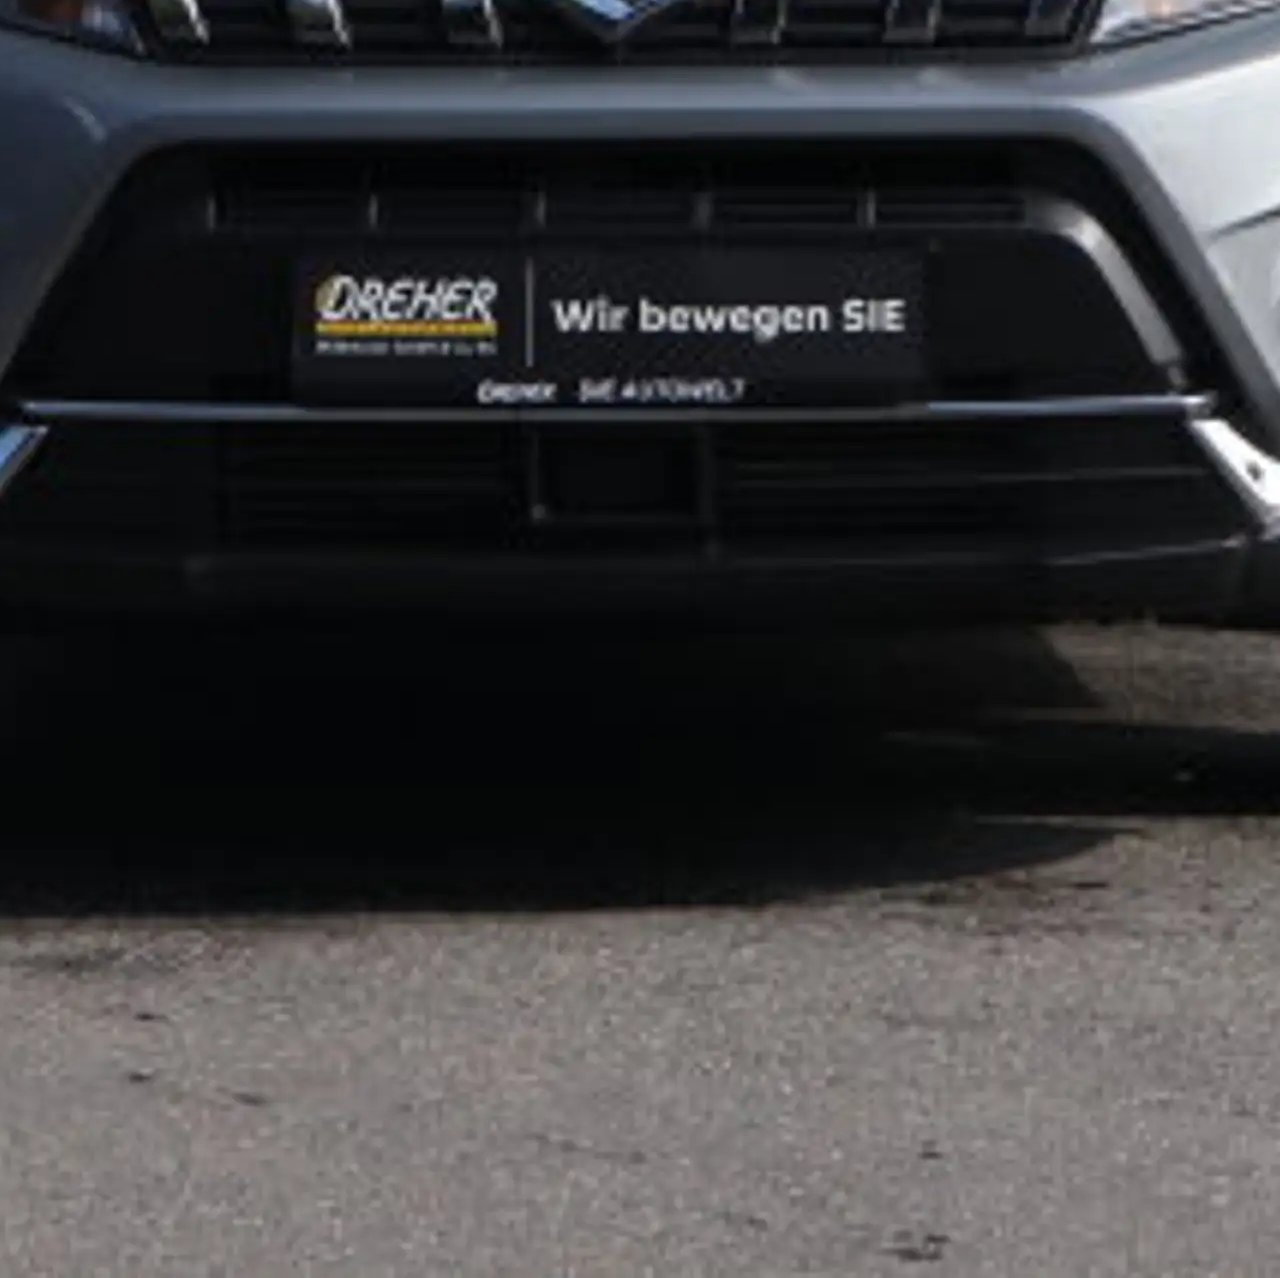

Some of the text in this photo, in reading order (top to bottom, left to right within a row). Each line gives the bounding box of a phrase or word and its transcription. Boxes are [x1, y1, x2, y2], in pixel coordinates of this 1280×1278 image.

[316, 275, 497, 324] DREHER
[551, 296, 906, 342] Wir bewegen SIE
